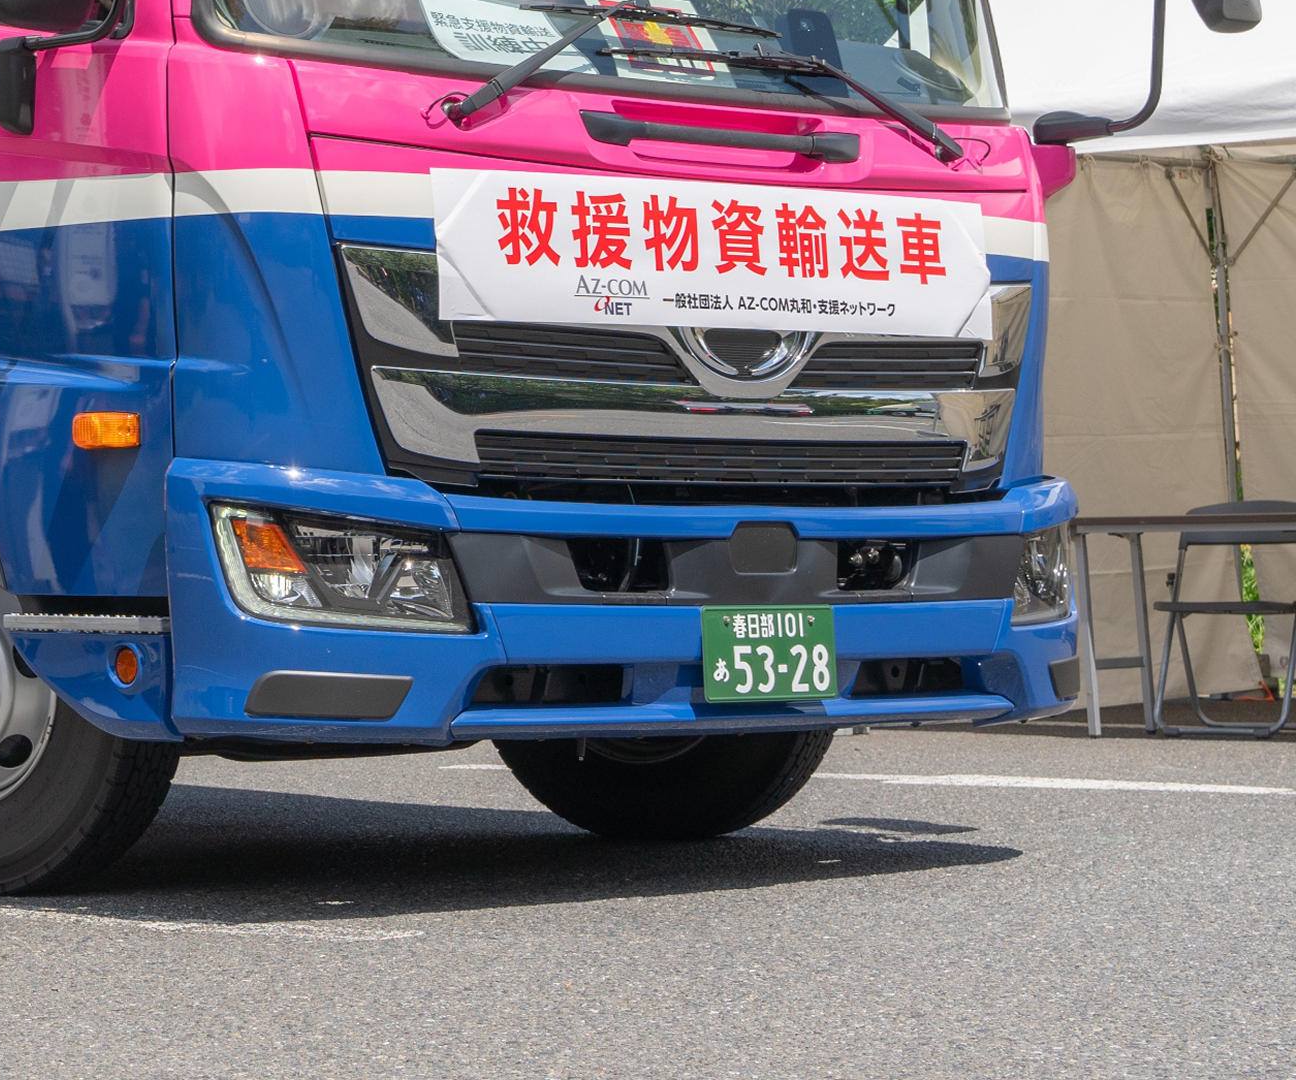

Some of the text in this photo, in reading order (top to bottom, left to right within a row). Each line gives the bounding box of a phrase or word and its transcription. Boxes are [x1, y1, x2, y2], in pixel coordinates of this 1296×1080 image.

[453, 31, 551, 54] 訓練中
[496, 187, 947, 285] 救援物資輸送車
[576, 274, 648, 296] AZ-COM
[662, 293, 896, 317] 一般社団法人 AZ-COM丸和・支援ネットワーク
[713, 644, 830, 694] あ 53-28
